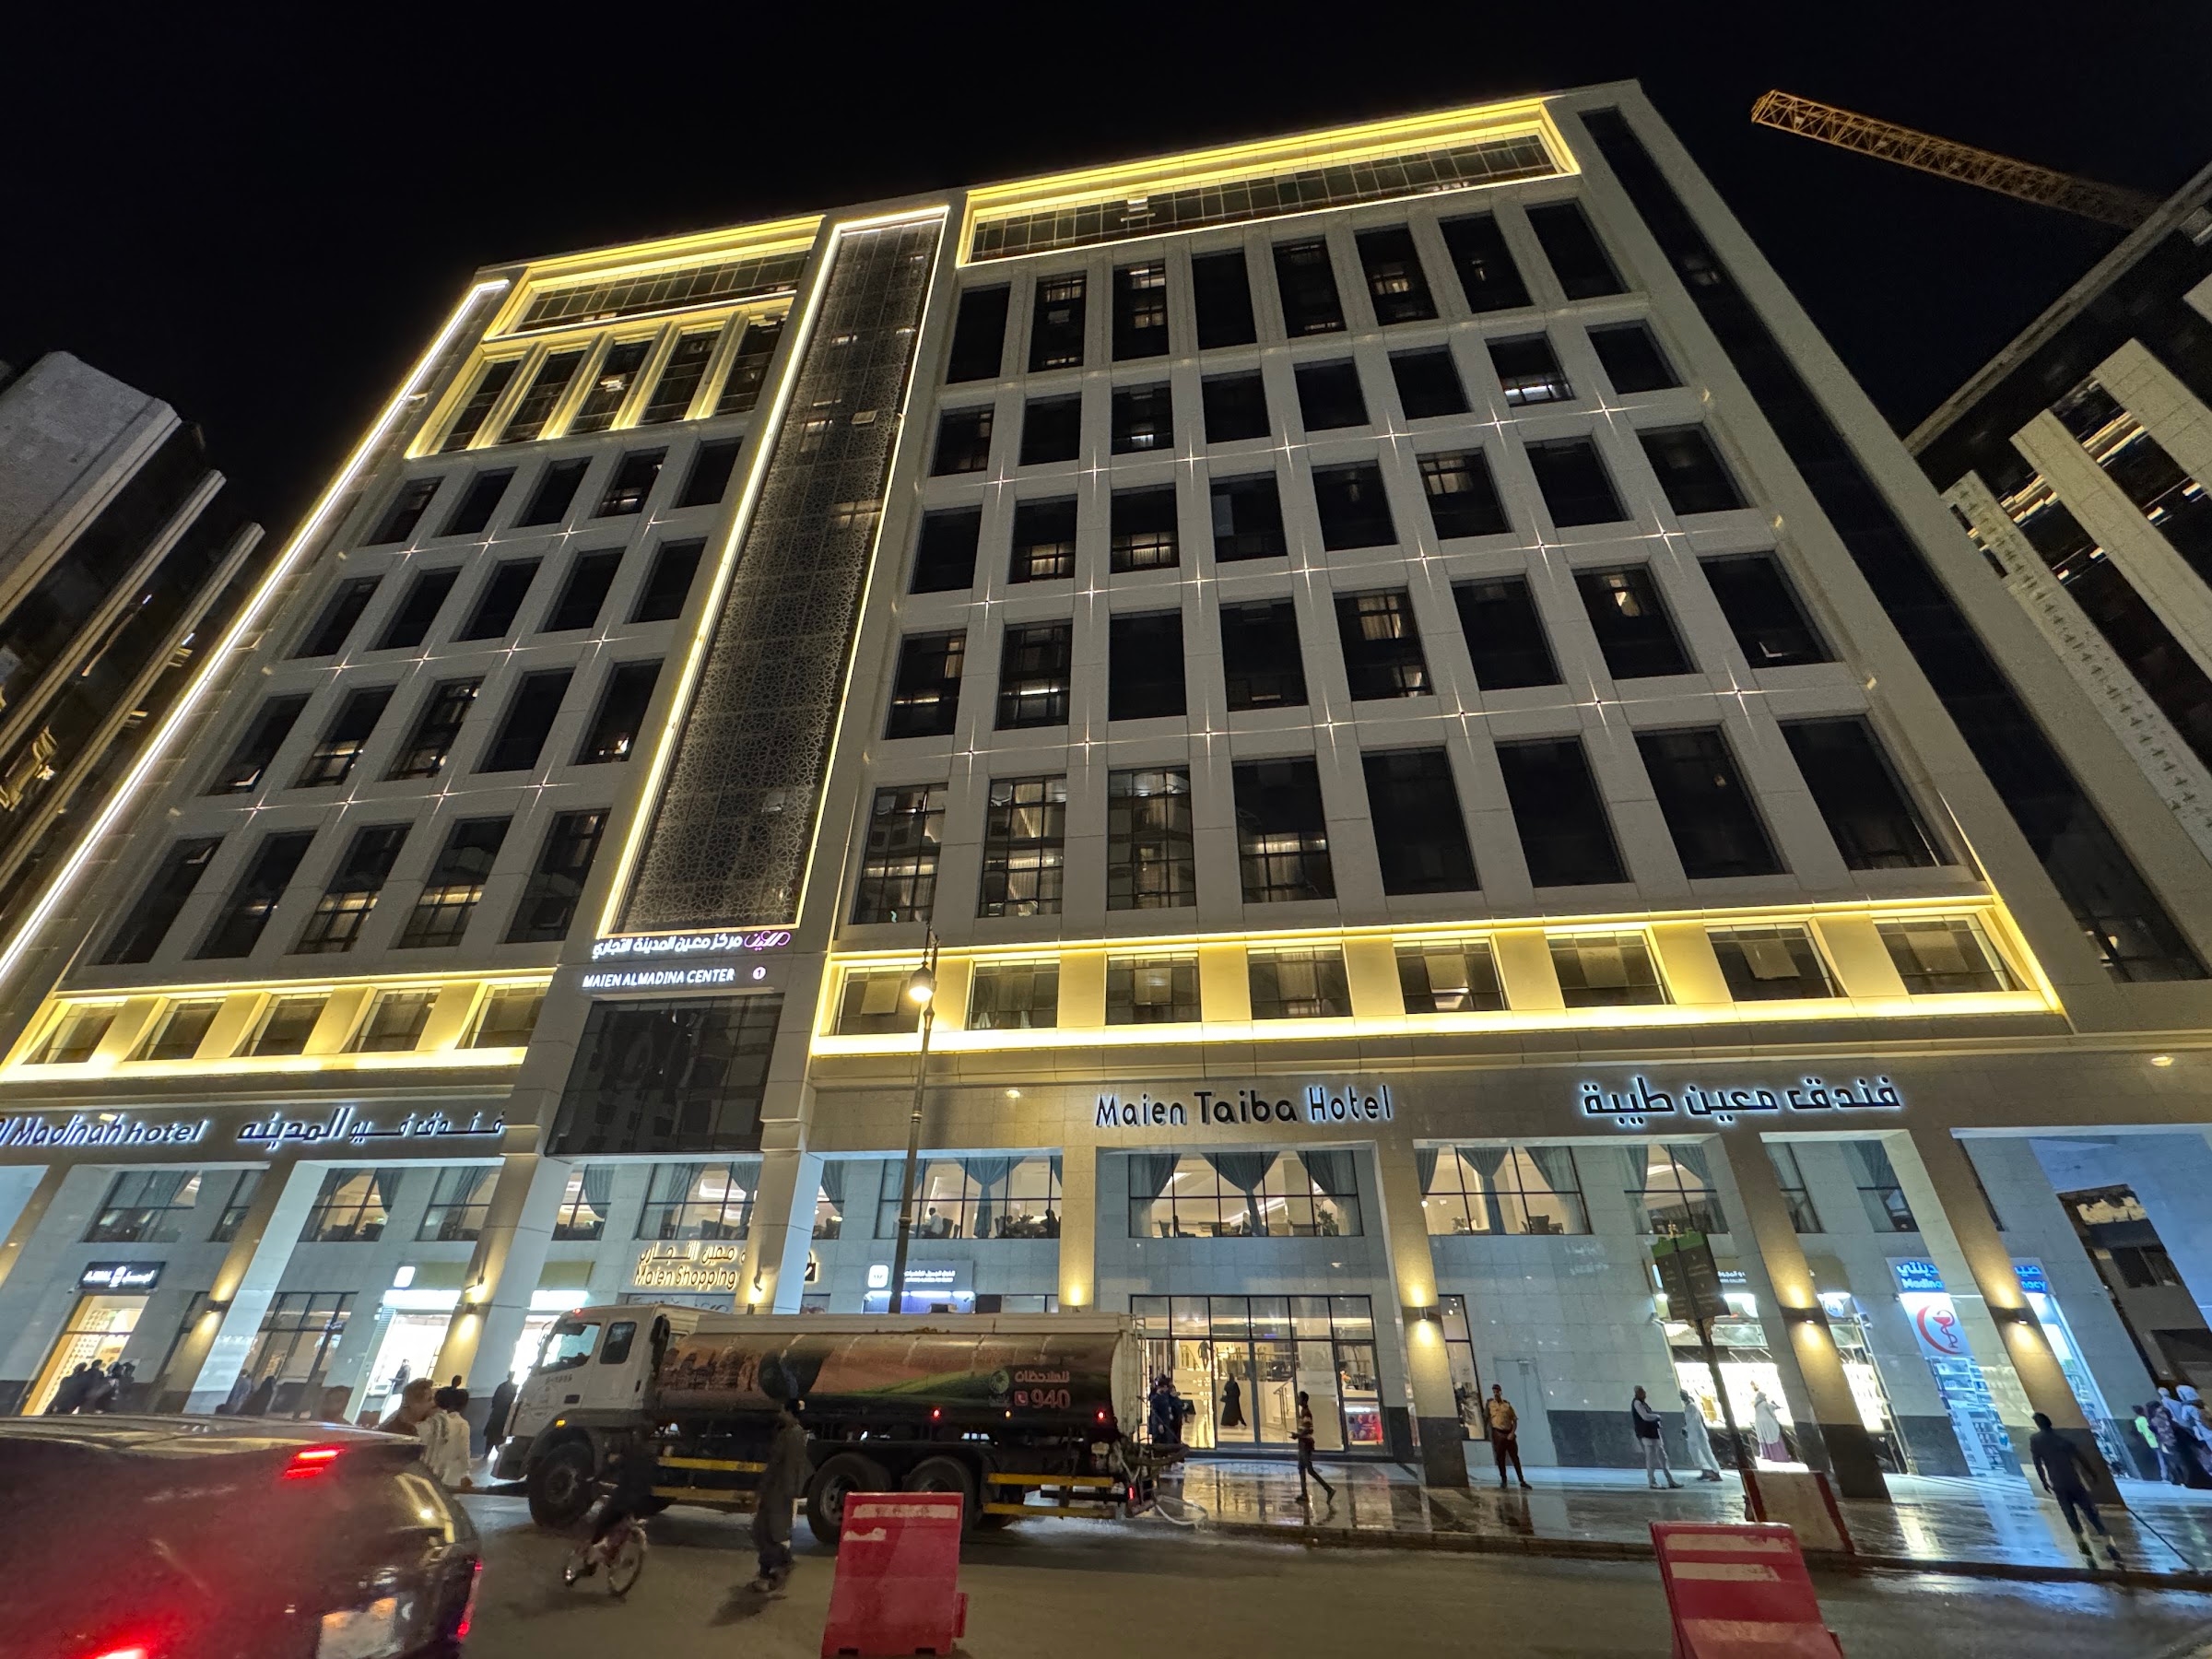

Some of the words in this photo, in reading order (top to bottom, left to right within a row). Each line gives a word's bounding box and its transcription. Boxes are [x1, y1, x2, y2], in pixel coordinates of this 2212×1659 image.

[592, 938, 633, 959] التجاري
[633, 935, 677, 954] المدينة
[675, 936, 711, 952] معين
[710, 933, 743, 950] مركز
[582, 973, 622, 988] MAIEN
[686, 968, 735, 983] CENTER
[1583, 1076, 1676, 1125] طيبة
[1684, 1085, 1779, 1123] معين
[1787, 1076, 1901, 1112] فندق
[1095, 1092, 1187, 1127] Maien
[1194, 1089, 1299, 1124] Taiba
[1306, 1084, 1393, 1123] Hotel
[9, 1113, 125, 1147] Madinah
[124, 1119, 209, 1145] hotel
[702, 1245, 737, 1265] معين
[634, 1265, 676, 1287] Maien
[676, 1265, 738, 1290] Shopping
[1896, 1261, 1939, 1277] دينتي
[1030, 1387, 1071, 1409] 940
